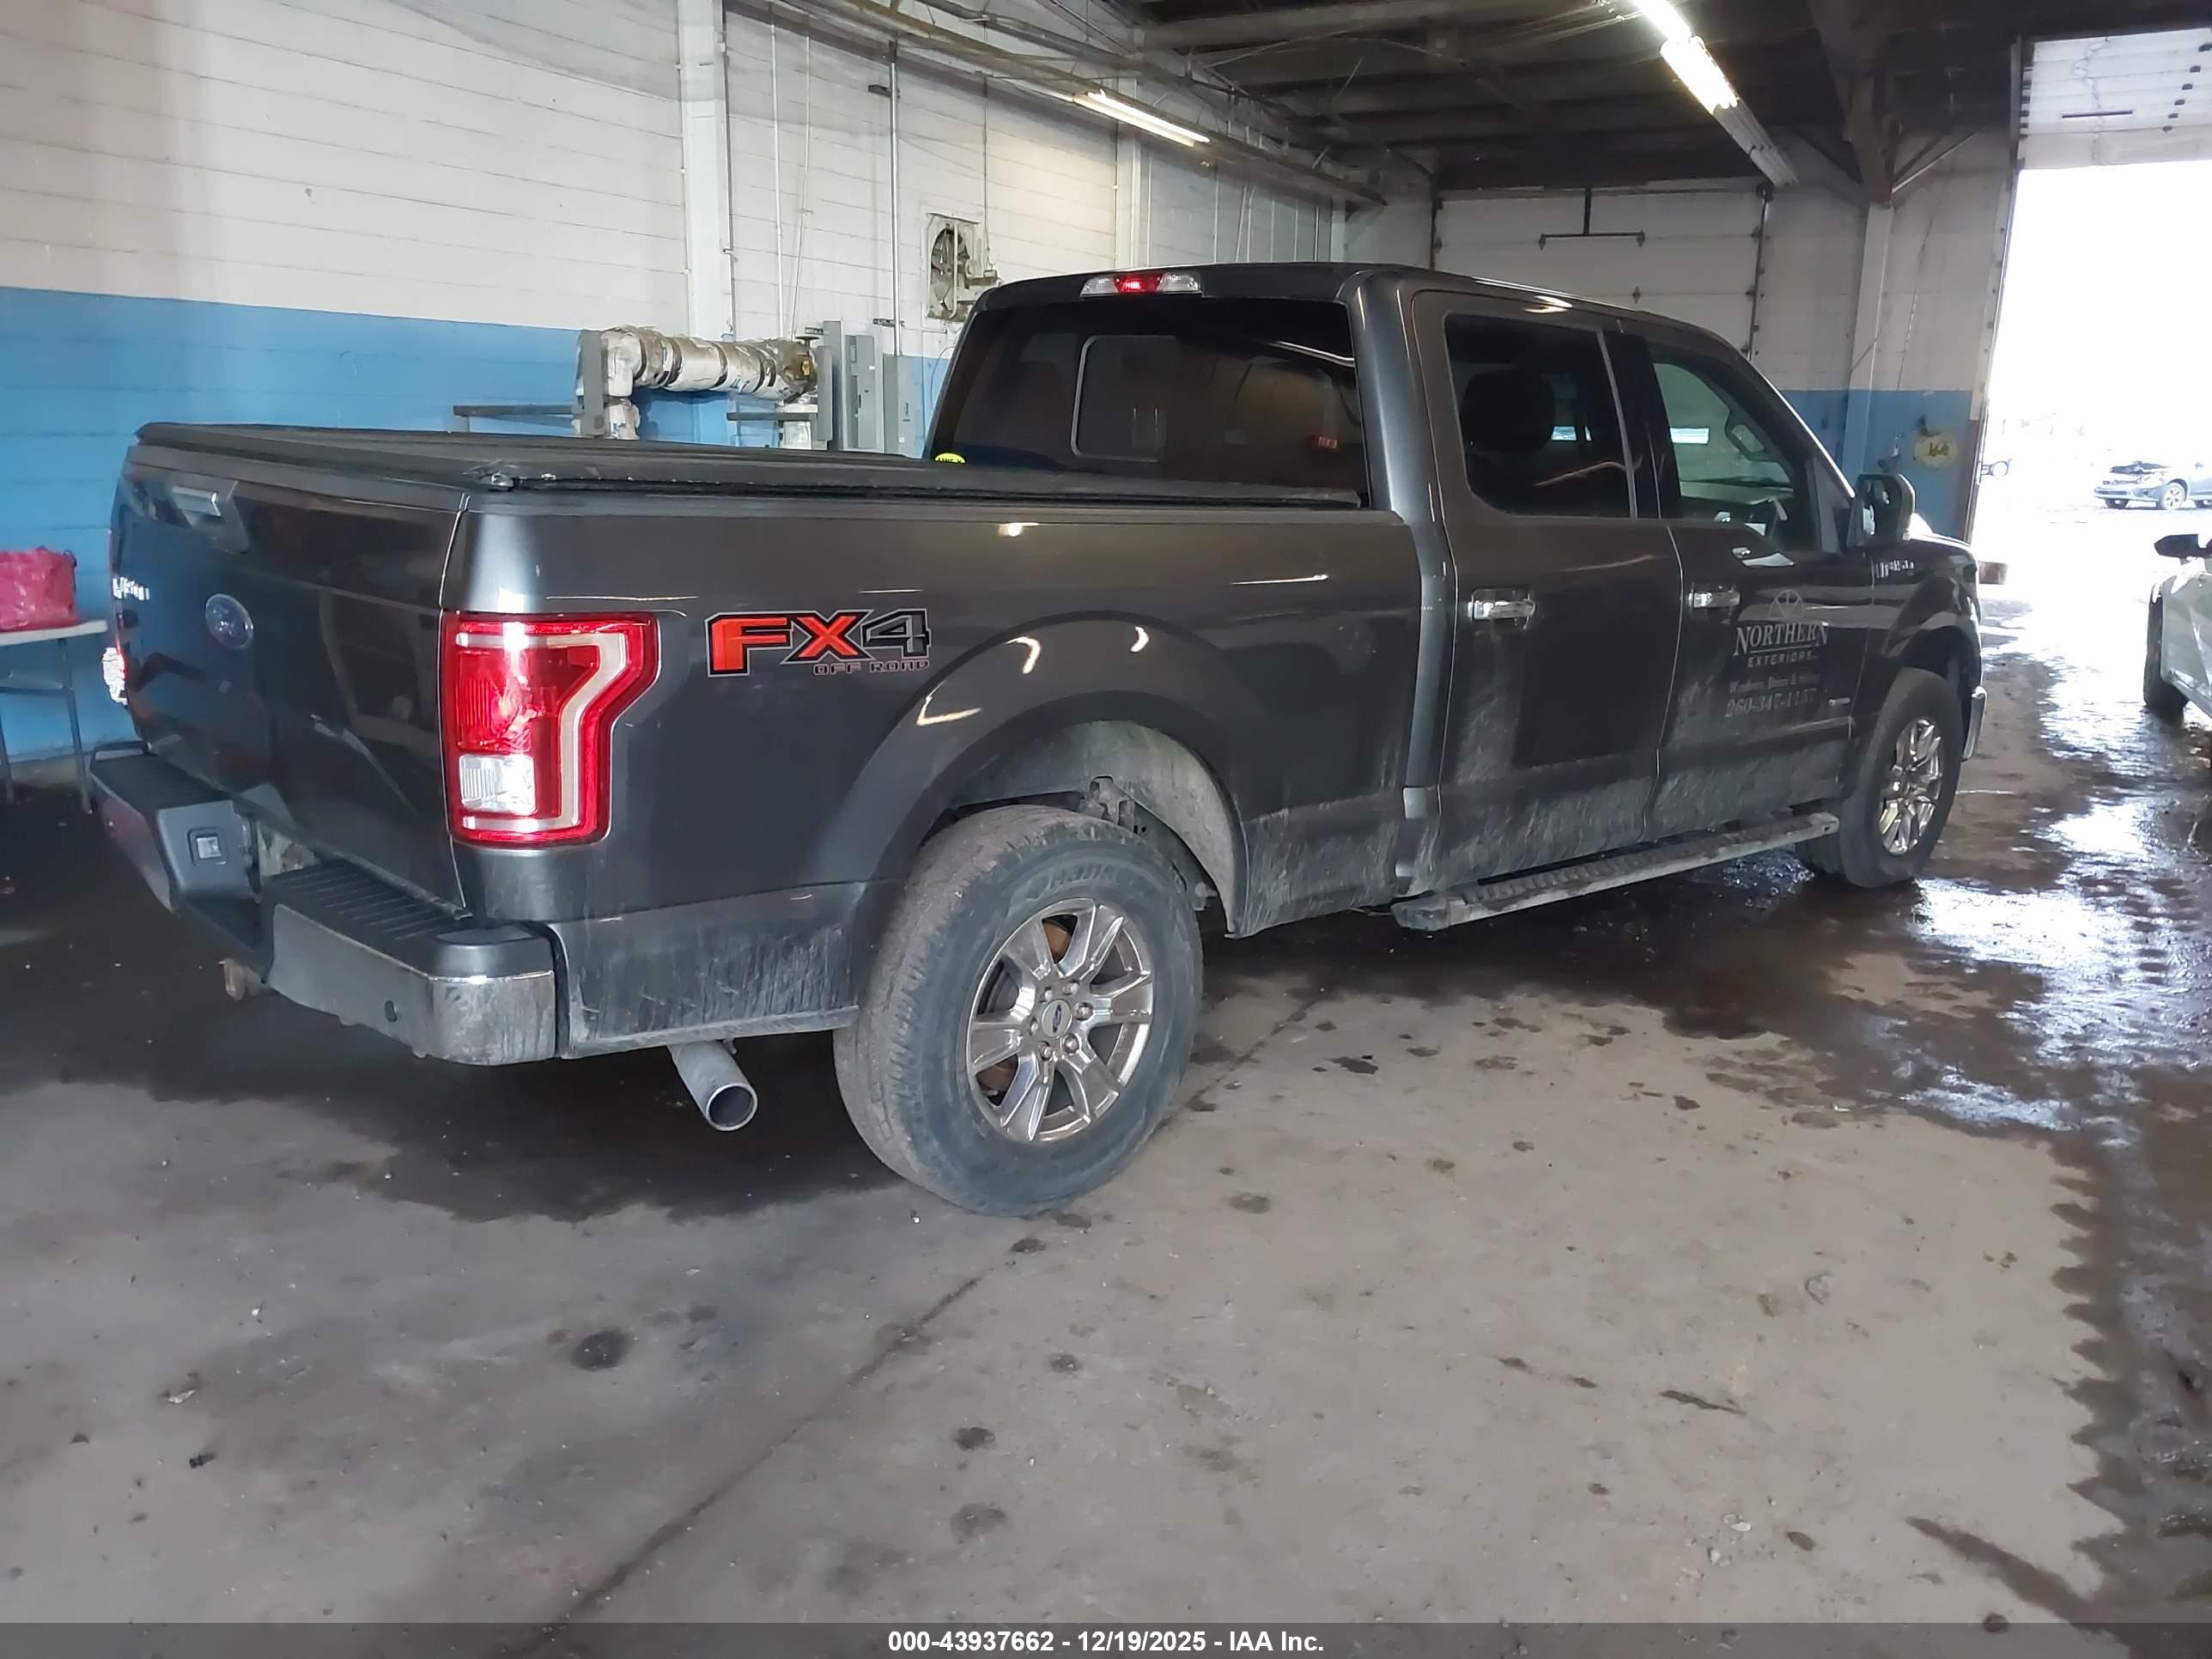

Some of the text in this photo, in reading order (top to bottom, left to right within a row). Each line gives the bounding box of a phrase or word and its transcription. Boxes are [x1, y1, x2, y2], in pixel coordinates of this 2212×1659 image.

[705, 608, 931, 678] FX4
[1732, 622, 1829, 657] NORTHERN
[813, 659, 931, 676] OFF ROAD
